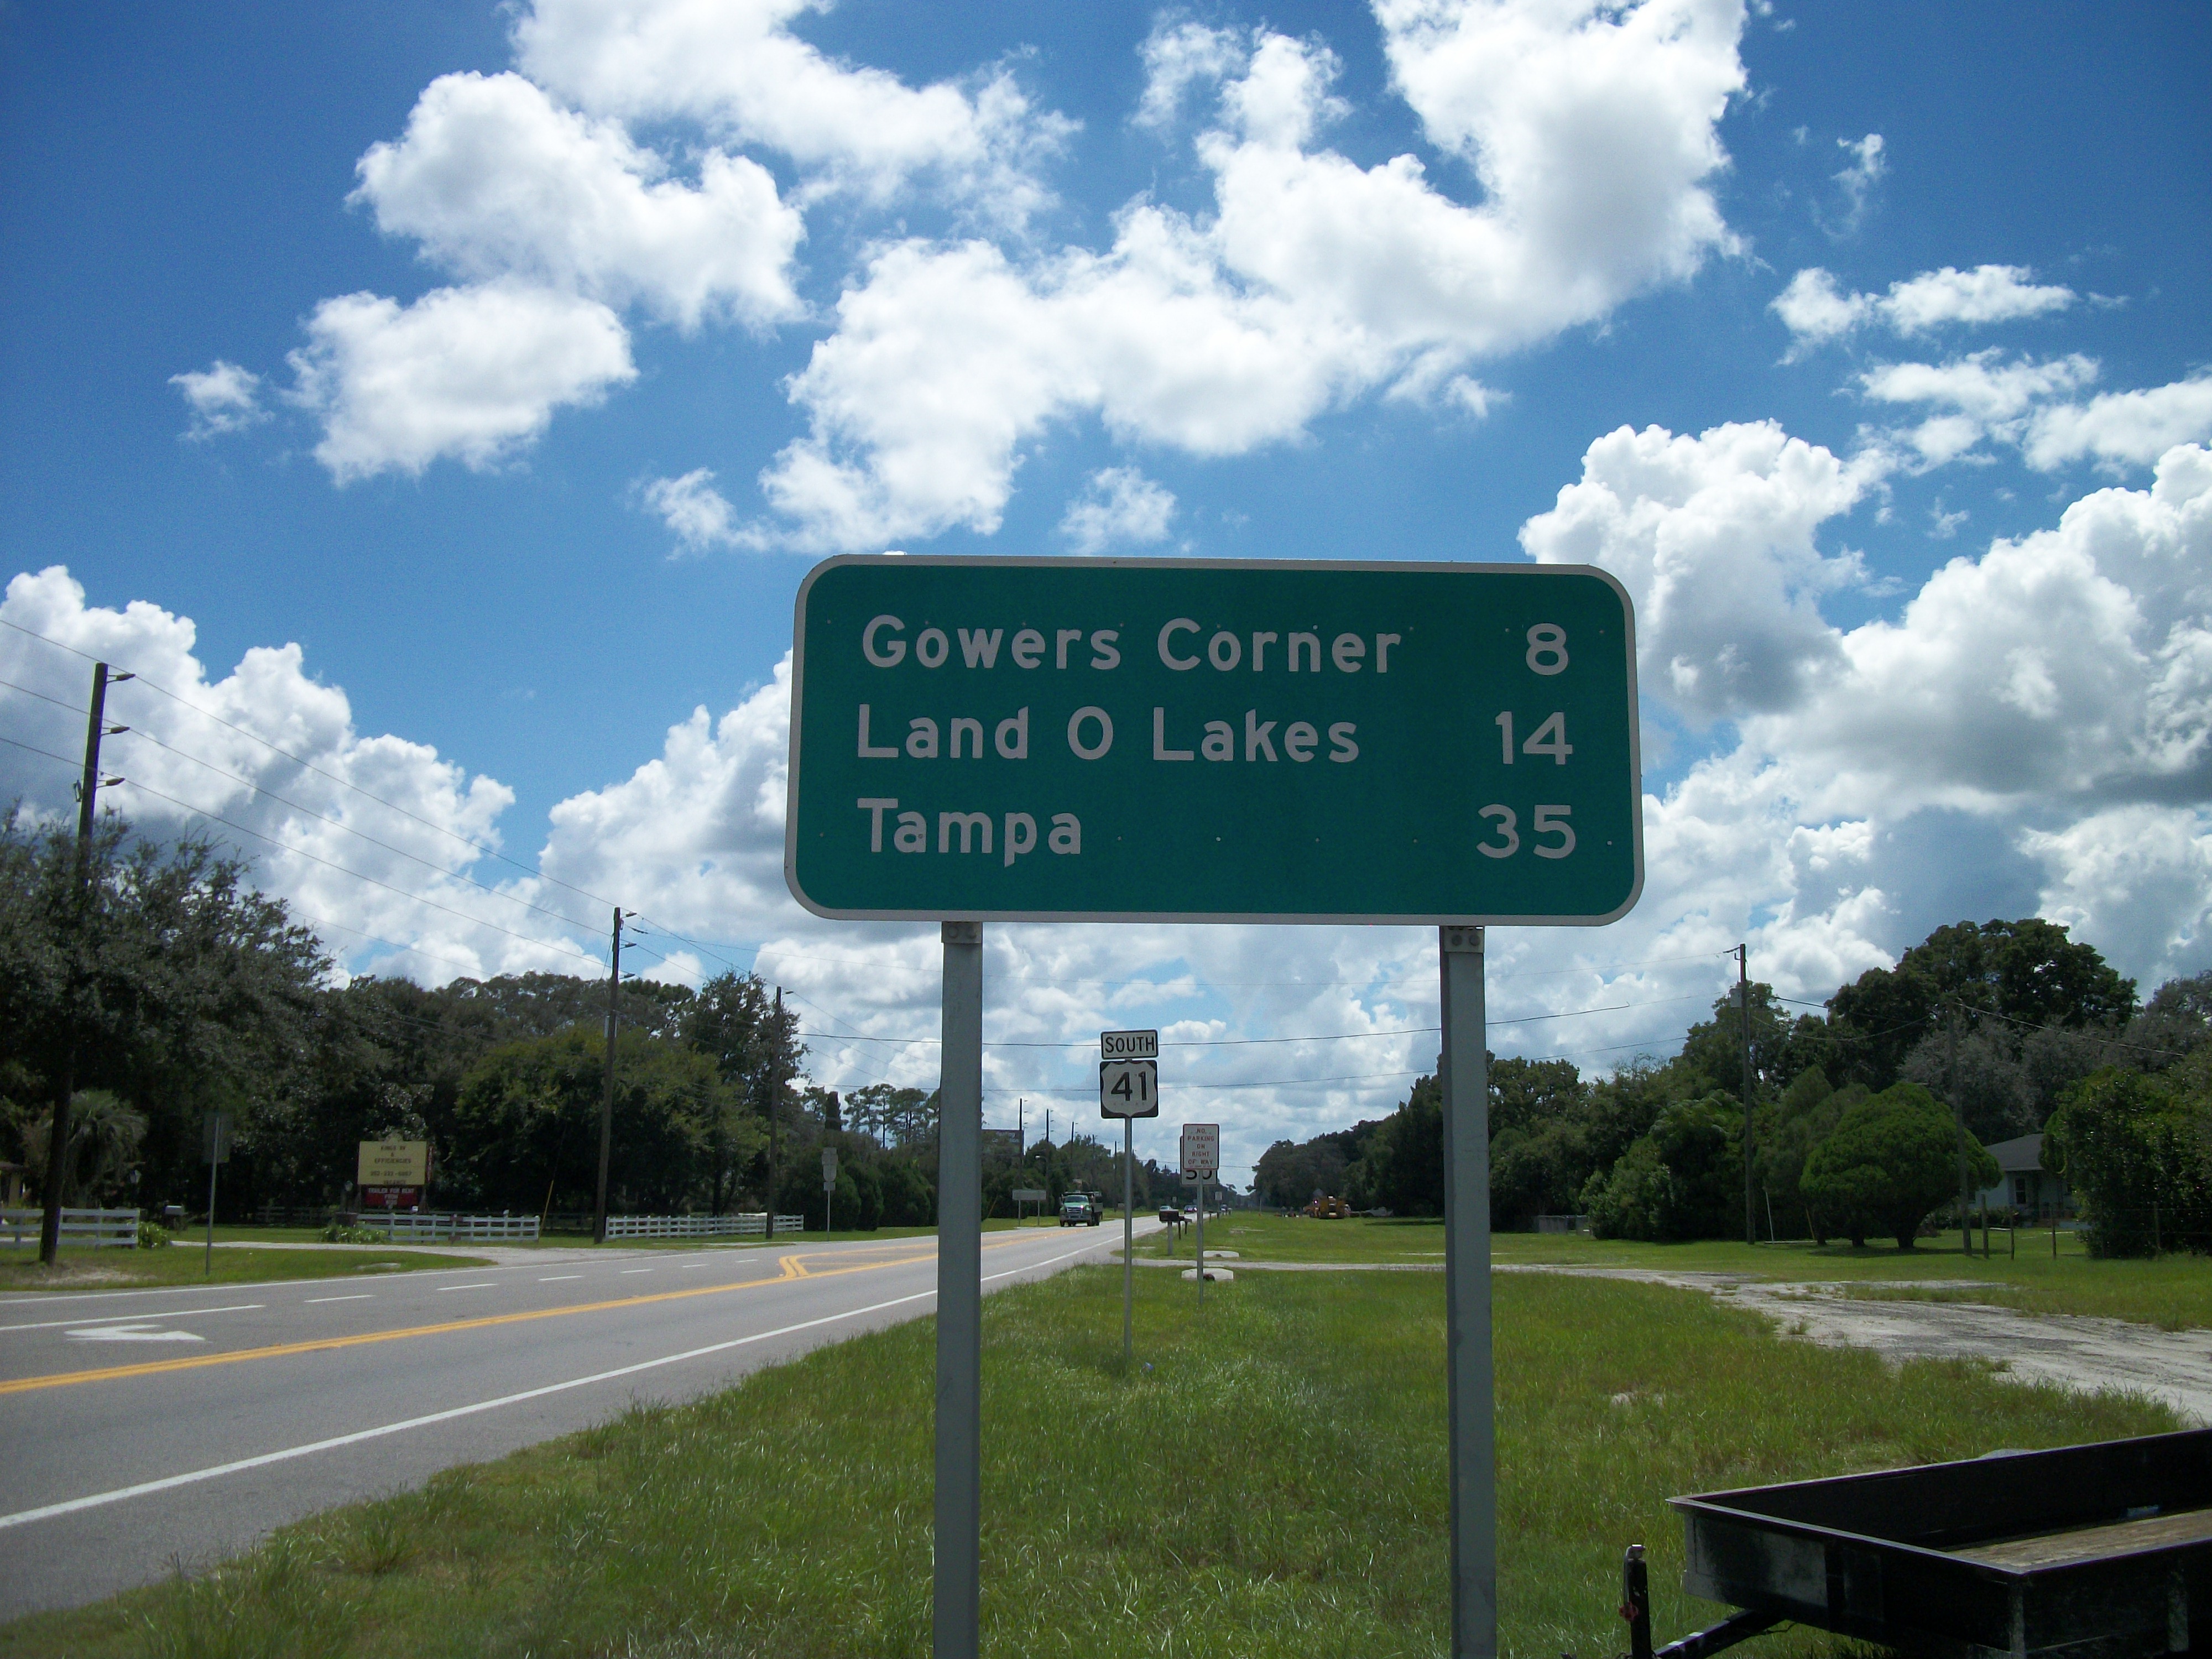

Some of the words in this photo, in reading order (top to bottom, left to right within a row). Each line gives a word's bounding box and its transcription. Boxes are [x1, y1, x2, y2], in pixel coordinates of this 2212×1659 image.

[863, 615, 1120, 670] Gowers
[1158, 618, 1401, 674] Corner
[1526, 623, 1568, 675] 8
[858, 704, 1029, 759] Land
[1068, 706, 1113, 760] O
[1154, 707, 1359, 763] Lakes
[1495, 711, 1573, 765] 14
[857, 798, 1081, 867] Tampa
[1477, 804, 1576, 859] 35
[1105, 1036, 1155, 1053] SOUTH
[1111, 1071, 1147, 1101] 41
